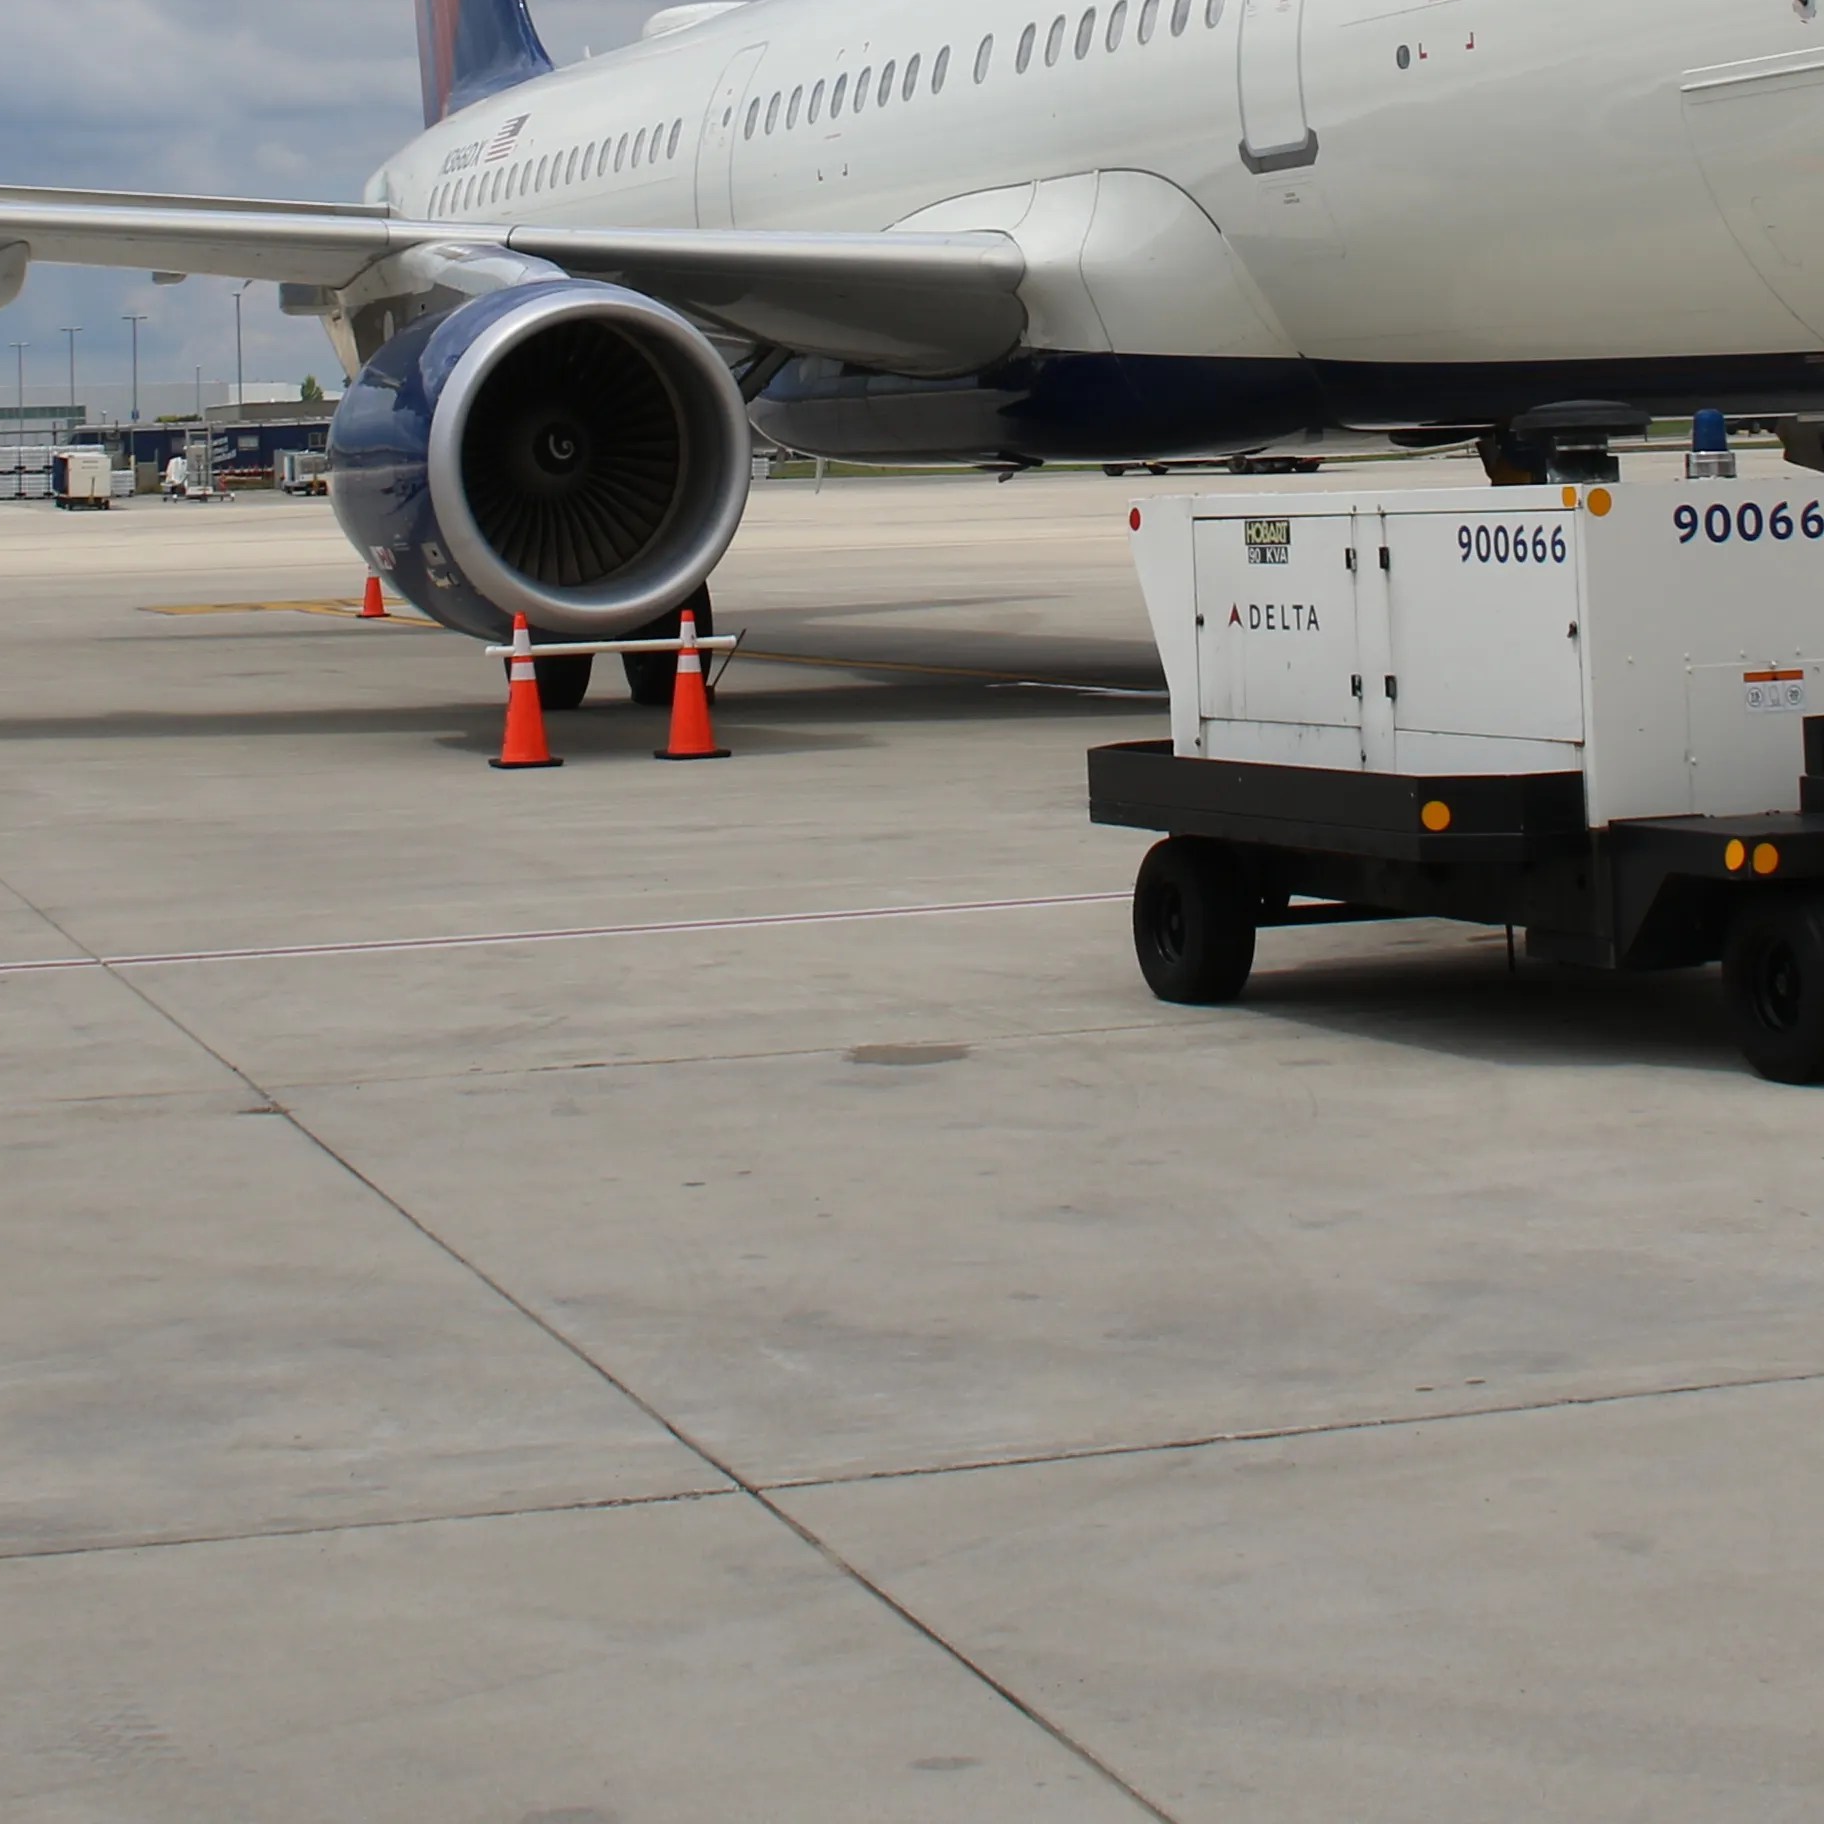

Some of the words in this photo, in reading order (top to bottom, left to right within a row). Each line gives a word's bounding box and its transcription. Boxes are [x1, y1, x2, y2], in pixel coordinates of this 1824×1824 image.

[1246, 521, 1289, 544] HOBART
[1458, 524, 1566, 563] 900666
[1249, 548, 1261, 563] 90
[1266, 548, 1288, 563] KVA
[1249, 604, 1320, 631] DELTA
